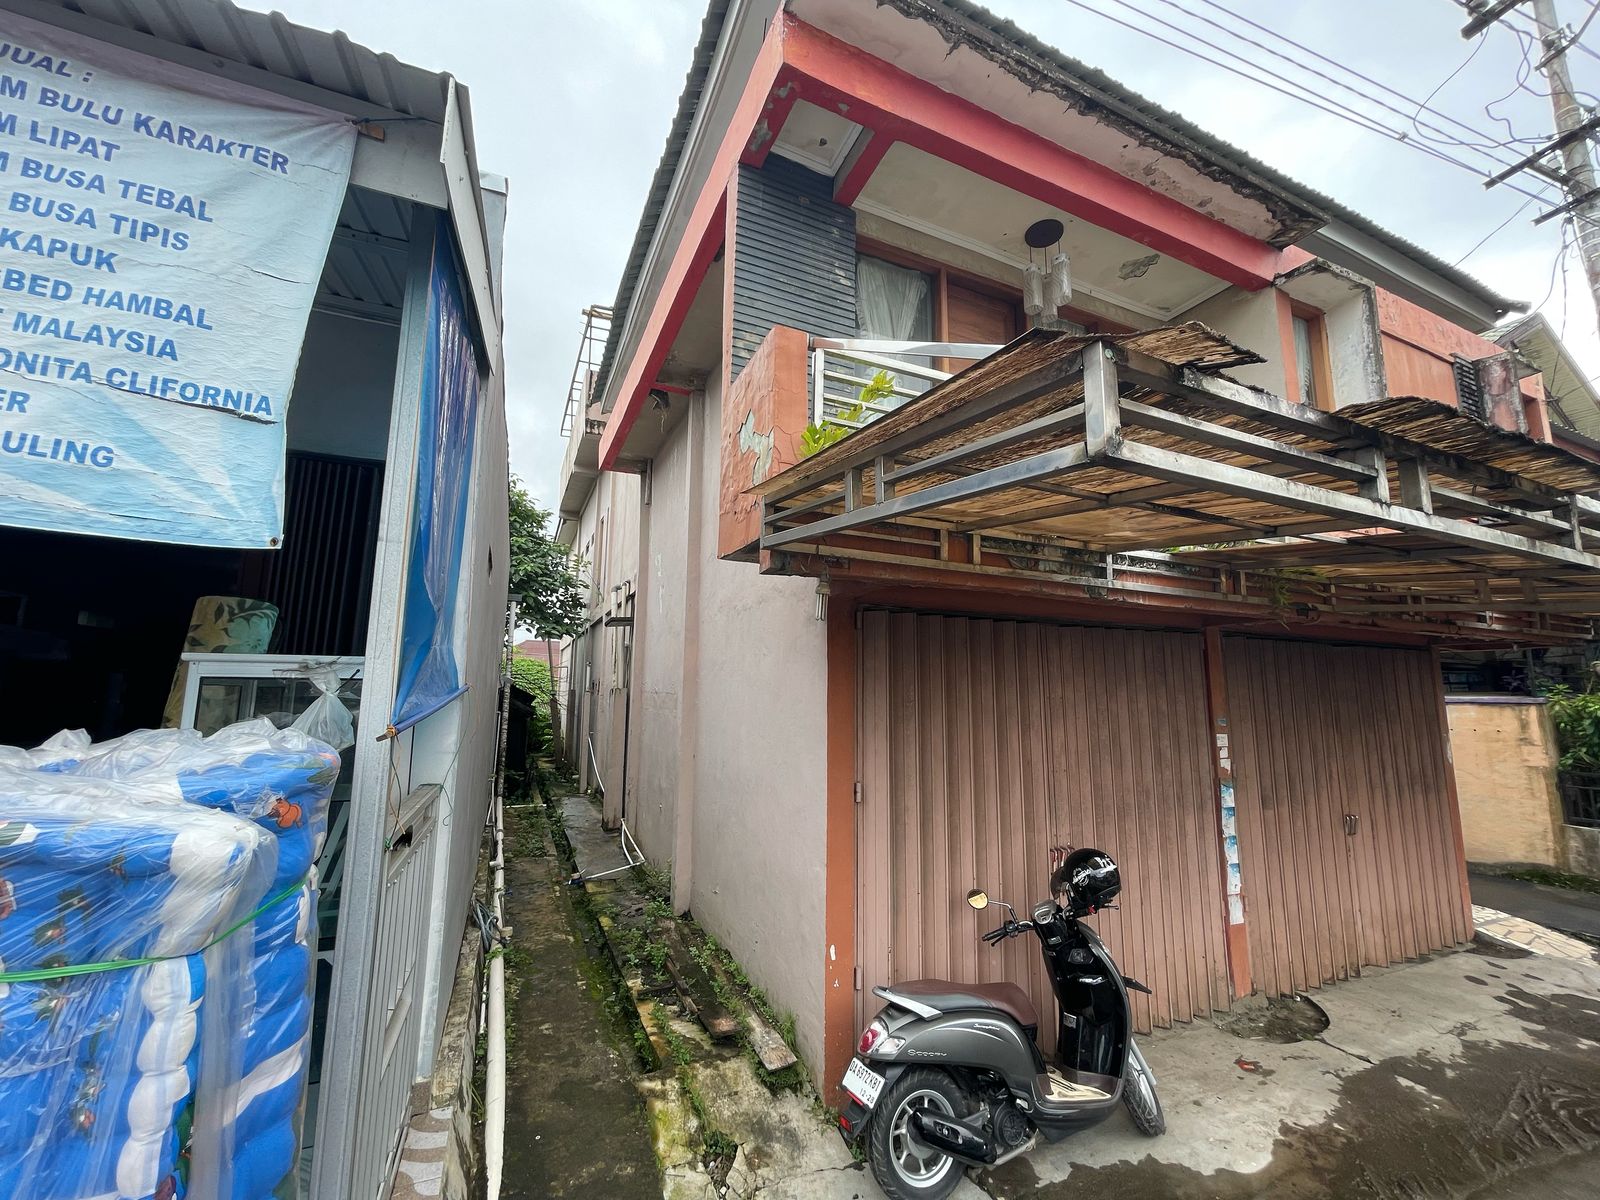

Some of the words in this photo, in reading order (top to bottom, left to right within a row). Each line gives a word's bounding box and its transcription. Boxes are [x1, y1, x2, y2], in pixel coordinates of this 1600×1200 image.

[29, 120, 121, 162] LIPAT
[38, 87, 124, 126] BULU
[133, 113, 290, 175] KARAKTER
[20, 157, 106, 194] BUSA
[119, 179, 214, 223] TEBAL
[9, 191, 98, 230] BUSA
[109, 213, 190, 251] TIPIS
[0, 227, 119, 274] KAPUK
[2, 268, 73, 302] BED
[82, 286, 214, 331] HAMBAL
[12, 311, 178, 362] MALAYSIA
[105, 367, 273, 416] CLIFORNIA
[2, 430, 115, 468] ULING
